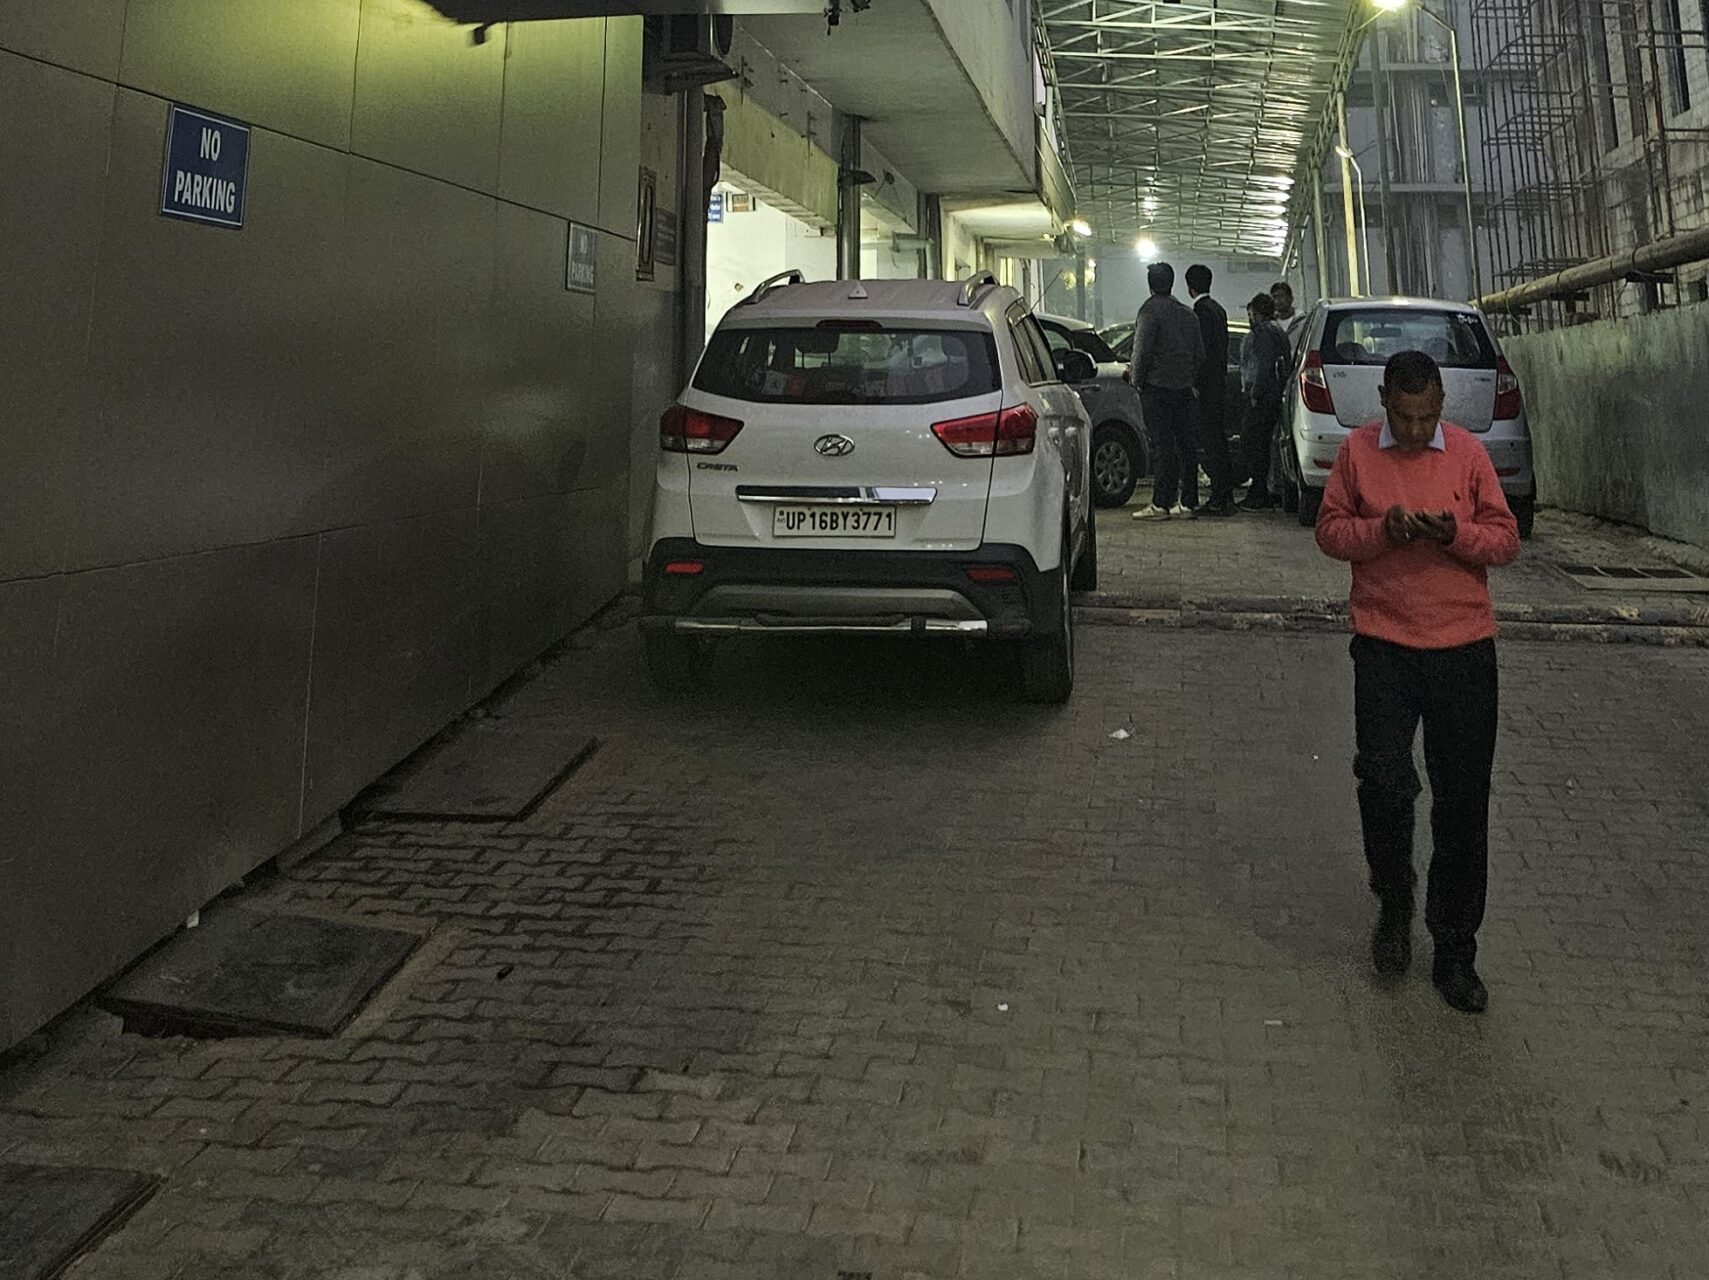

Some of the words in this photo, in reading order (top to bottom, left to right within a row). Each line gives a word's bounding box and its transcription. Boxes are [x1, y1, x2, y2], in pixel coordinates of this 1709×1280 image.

[200, 127, 221, 161] NO
[174, 170, 236, 214] PARKING
[786, 511, 892, 531] UP16BY3771
